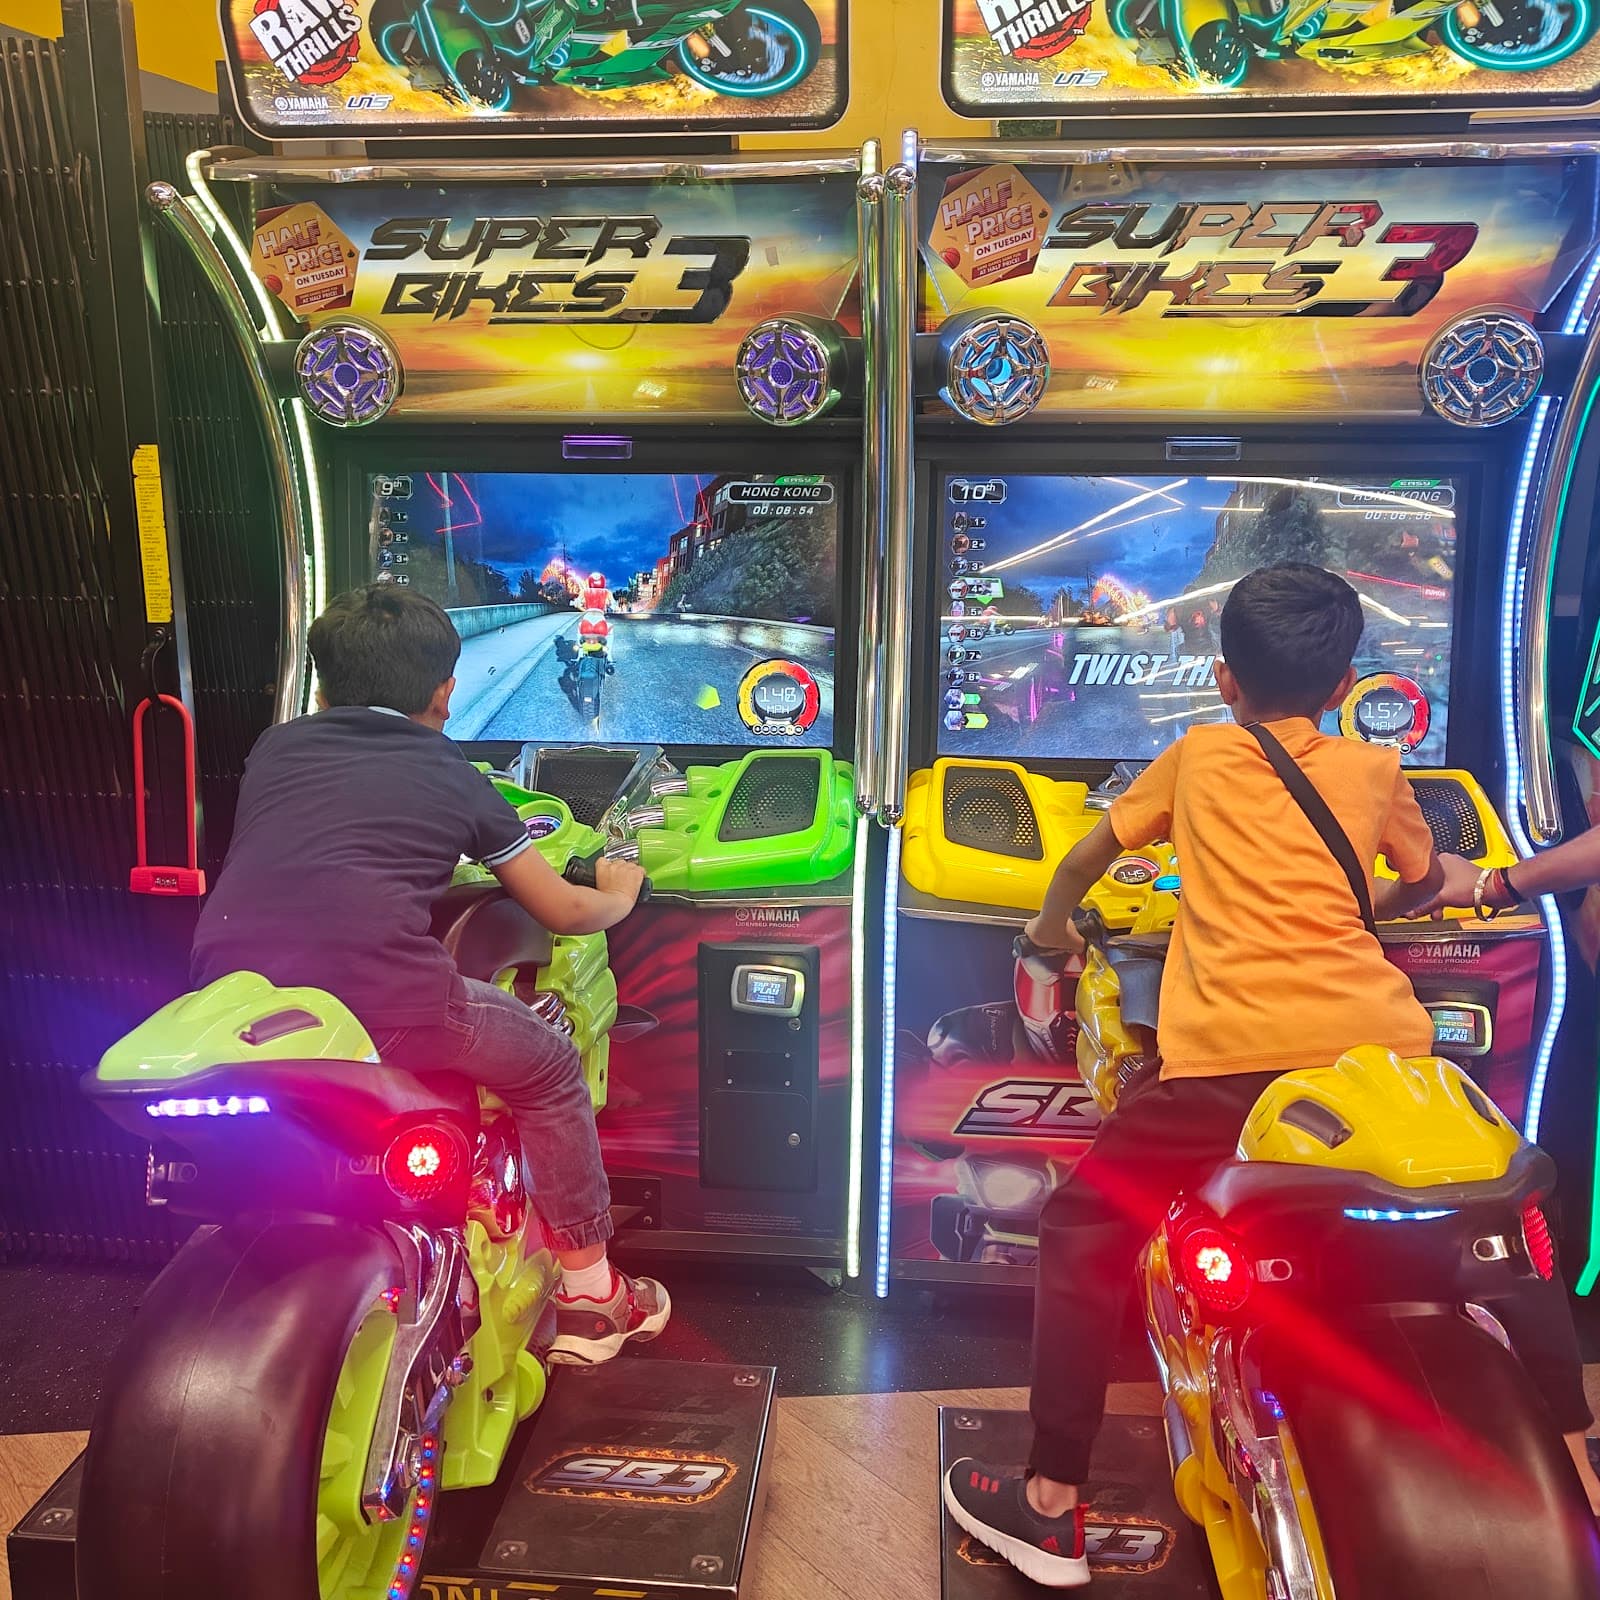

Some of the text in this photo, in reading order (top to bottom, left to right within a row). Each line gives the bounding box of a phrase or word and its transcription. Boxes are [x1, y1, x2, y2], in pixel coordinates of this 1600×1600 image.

[274, 4, 362, 82] THRILLS
[995, 72, 1040, 86] YAMAHA
[287, 97, 329, 110] YAMAHA
[941, 179, 1013, 230] HALF
[967, 201, 1034, 245] PRICE
[1043, 200, 1385, 258] SUPER
[257, 219, 321, 259] HALF
[363, 213, 663, 267] SUPER
[976, 230, 1033, 256] ON TUESDAY
[284, 240, 344, 275] PRICE
[296, 267, 345, 286] ON TUESDAY
[1046, 221, 1479, 318] BIKES 3
[379, 234, 752, 325] BIKES 3
[741, 486, 822, 497] HONG KONG
[961, 483, 996, 500] 10th
[1400, 490, 1442, 502] KONG
[752, 505, 815, 516] 00:08:54
[1068, 654, 1218, 687] TWIST TH
[766, 704, 790, 714] MPH
[1364, 702, 1404, 719] 157
[1371, 721, 1396, 732] MPH
[1120, 869, 1146, 880] 145
[751, 908, 800, 922] YAMAHA
[1425, 944, 1481, 958] YAMAHA
[1438, 1033, 1468, 1041] PLAY
[955, 1081, 1103, 1137] SB
[544, 1457, 726, 1494] SB3
